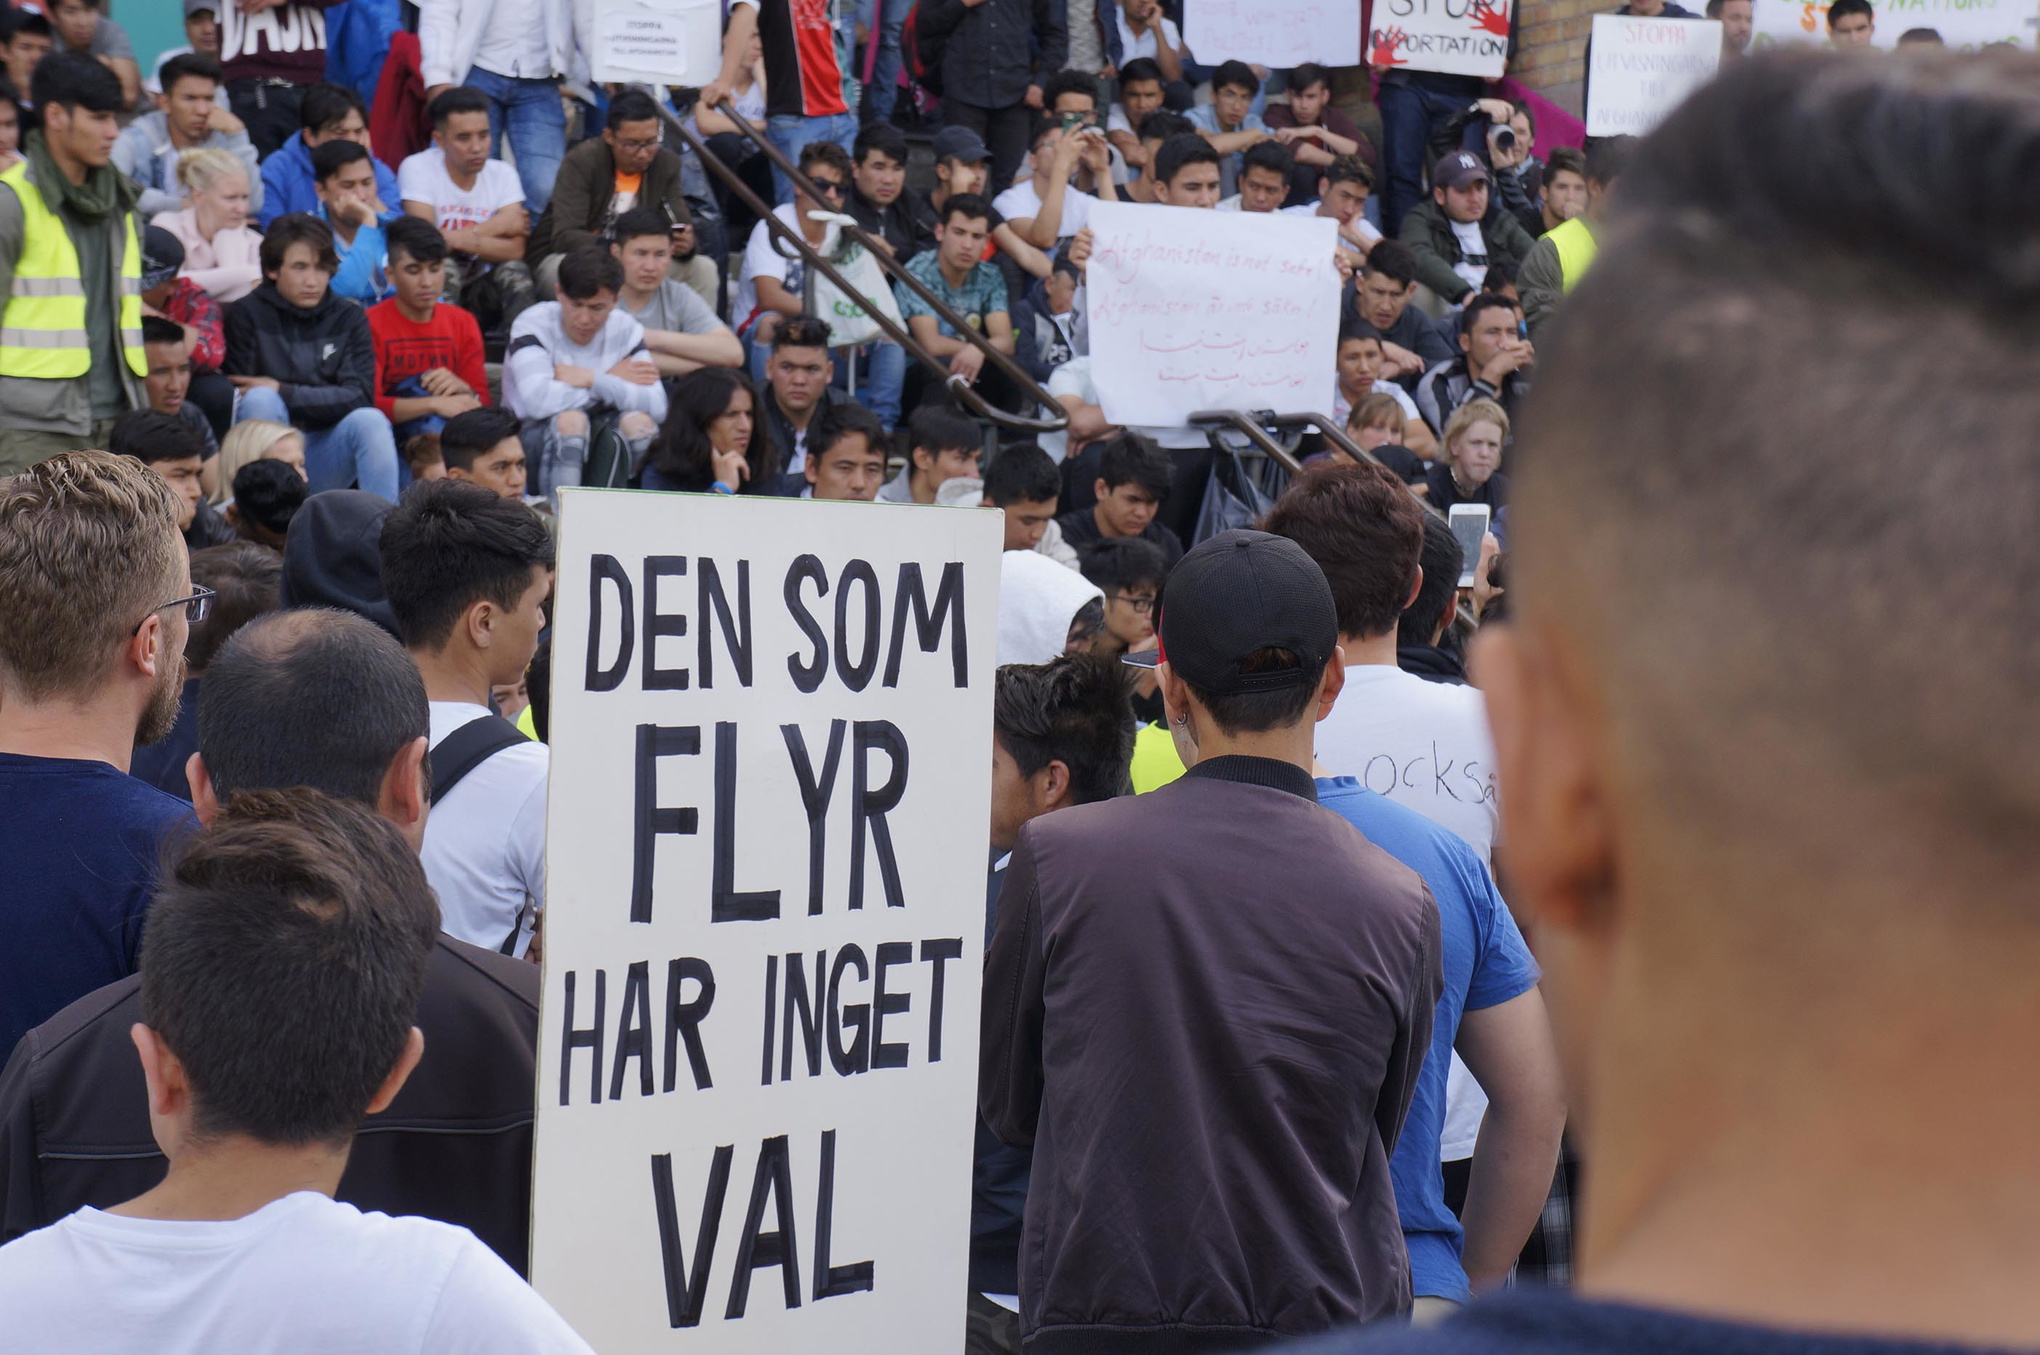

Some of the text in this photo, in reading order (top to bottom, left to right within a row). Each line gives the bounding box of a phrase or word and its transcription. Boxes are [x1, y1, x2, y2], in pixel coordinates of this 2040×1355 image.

[585, 554, 968, 693] DEN SOM
[630, 719, 909, 924] FLYR
[560, 937, 962, 1106] HAR INGET
[651, 1129, 874, 1328] VAL
